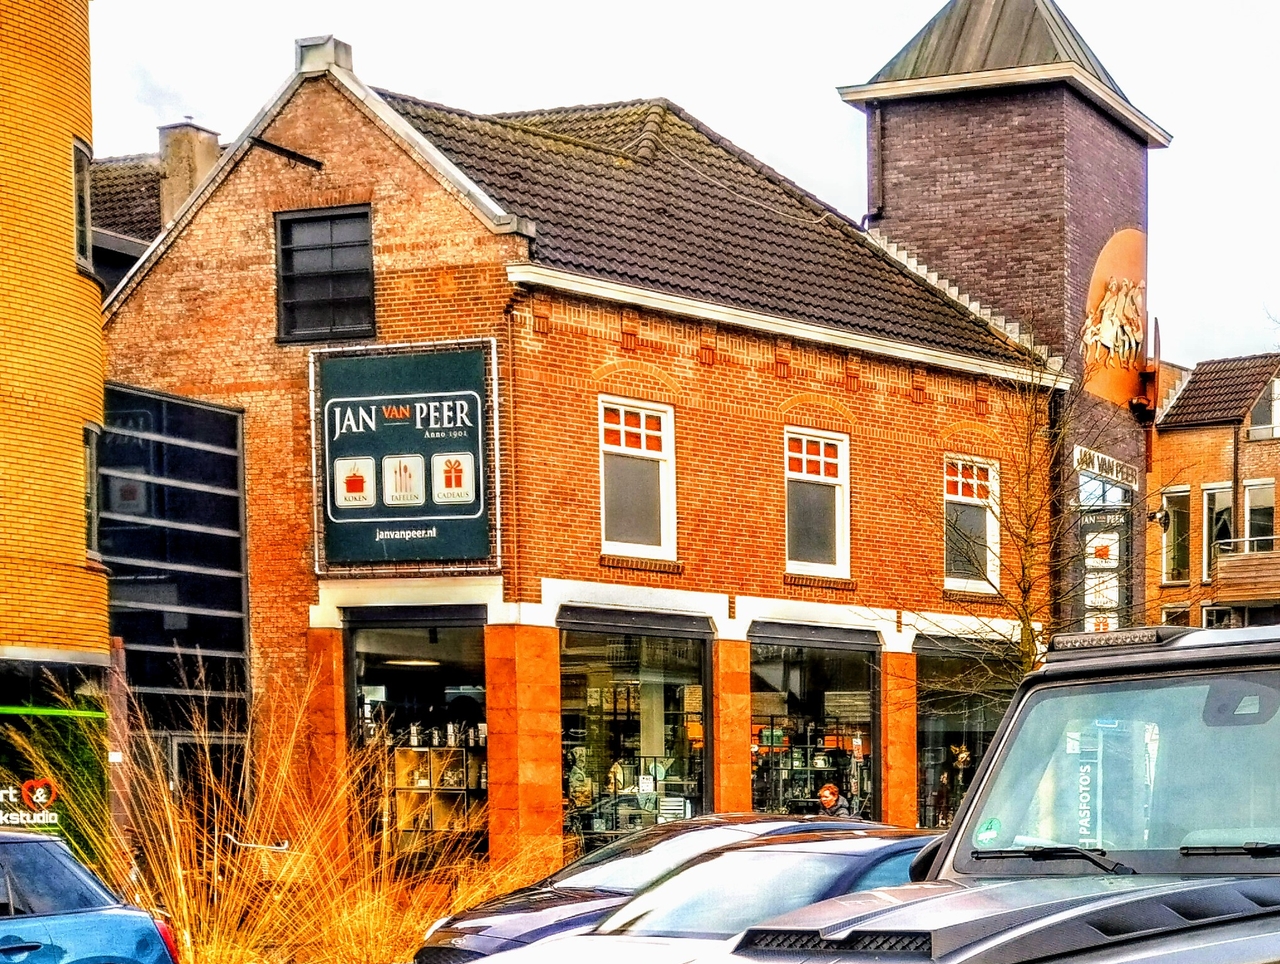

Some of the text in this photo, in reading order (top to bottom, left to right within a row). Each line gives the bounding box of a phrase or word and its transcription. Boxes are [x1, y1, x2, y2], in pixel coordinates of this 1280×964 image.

[333, 400, 474, 441] JAN VAN PEER
[424, 430, 468, 438] Anno 1901
[1077, 448, 1138, 486] JAN VAN PEER
[391, 494, 420, 502] TAFELEN
[437, 491, 470, 500] CADEAUS
[375, 526, 437, 542] janvanpeer.nl
[1078, 764, 1092, 835] PASFOTO'S
